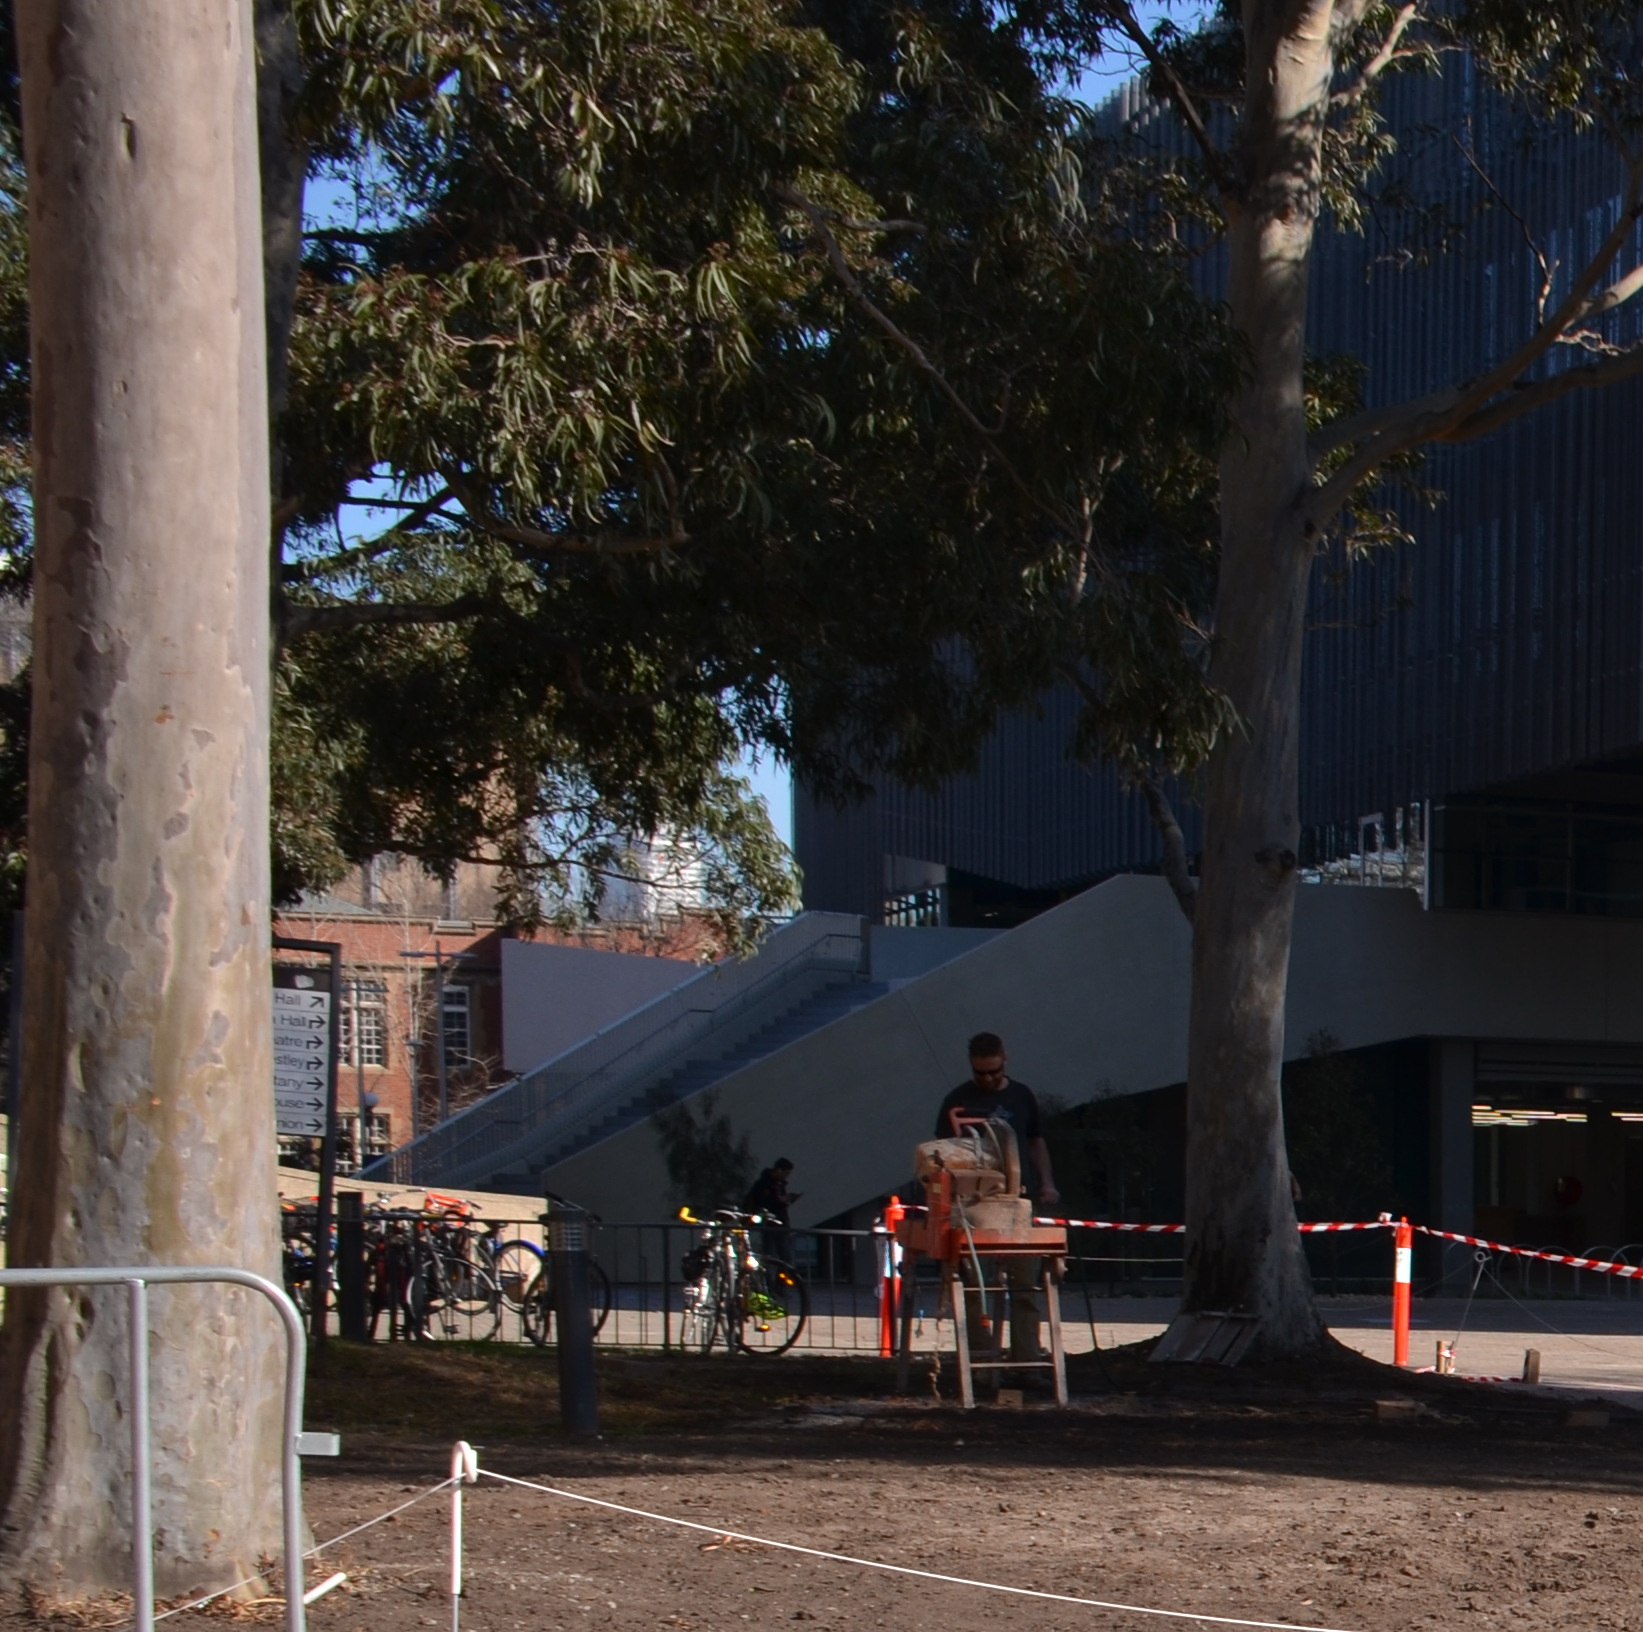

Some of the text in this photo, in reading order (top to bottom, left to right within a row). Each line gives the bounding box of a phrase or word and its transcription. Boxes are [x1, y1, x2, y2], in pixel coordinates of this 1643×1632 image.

[275, 993, 301, 1006] Hall
[281, 1015, 306, 1027] Hall
[274, 1036, 303, 1047] atre
[274, 1055, 304, 1069] stley
[274, 1076, 304, 1090] tany
[277, 1117, 304, 1129] nion
